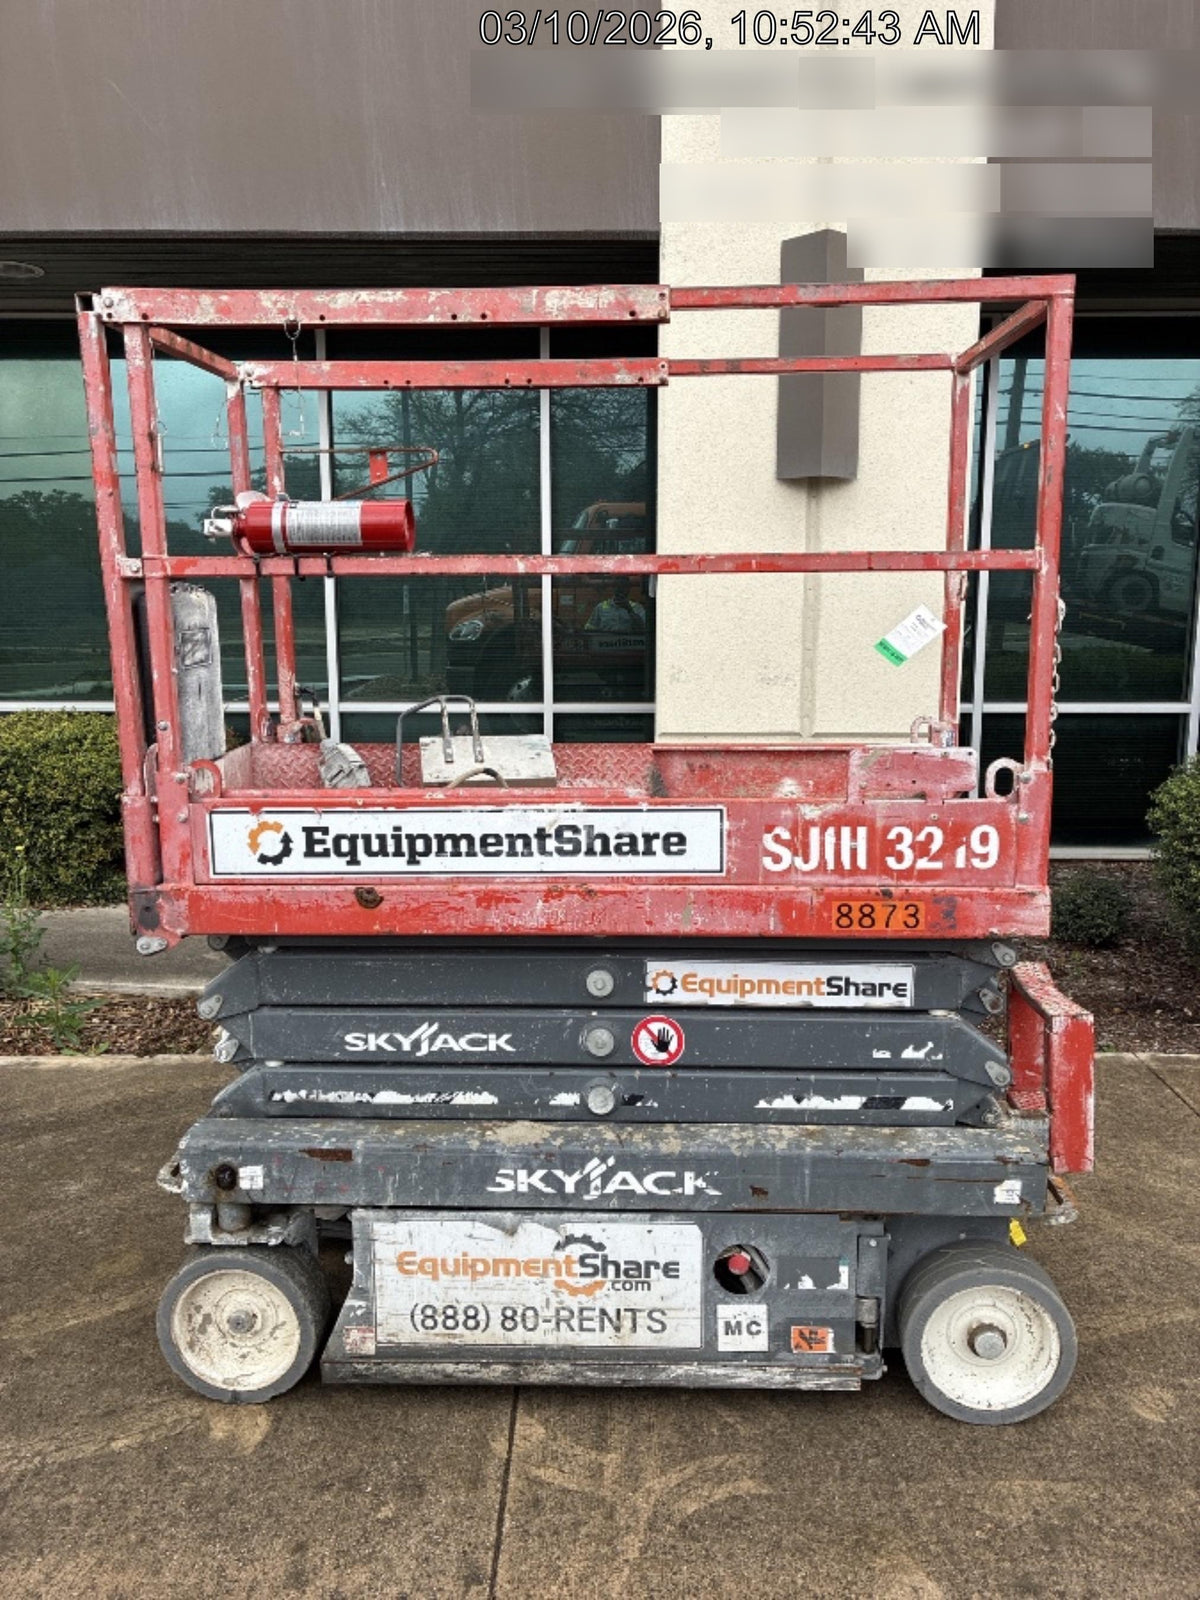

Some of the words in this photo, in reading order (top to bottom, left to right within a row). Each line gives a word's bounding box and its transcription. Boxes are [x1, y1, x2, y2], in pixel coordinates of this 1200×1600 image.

[301, 823, 688, 866] EquipmentShare
[835, 903, 921, 929] 8873
[681, 972, 908, 999] EquipmentShare
[344, 1021, 516, 1057] SKYJACK
[486, 1155, 723, 1200] SKYJACK
[396, 1251, 680, 1282] EquipmentShare
[607, 1279, 651, 1292] .com
[410, 1303, 491, 1333] (888)
[500, 1304, 668, 1335] 80-RENTS
[724, 1320, 762, 1336] MC
